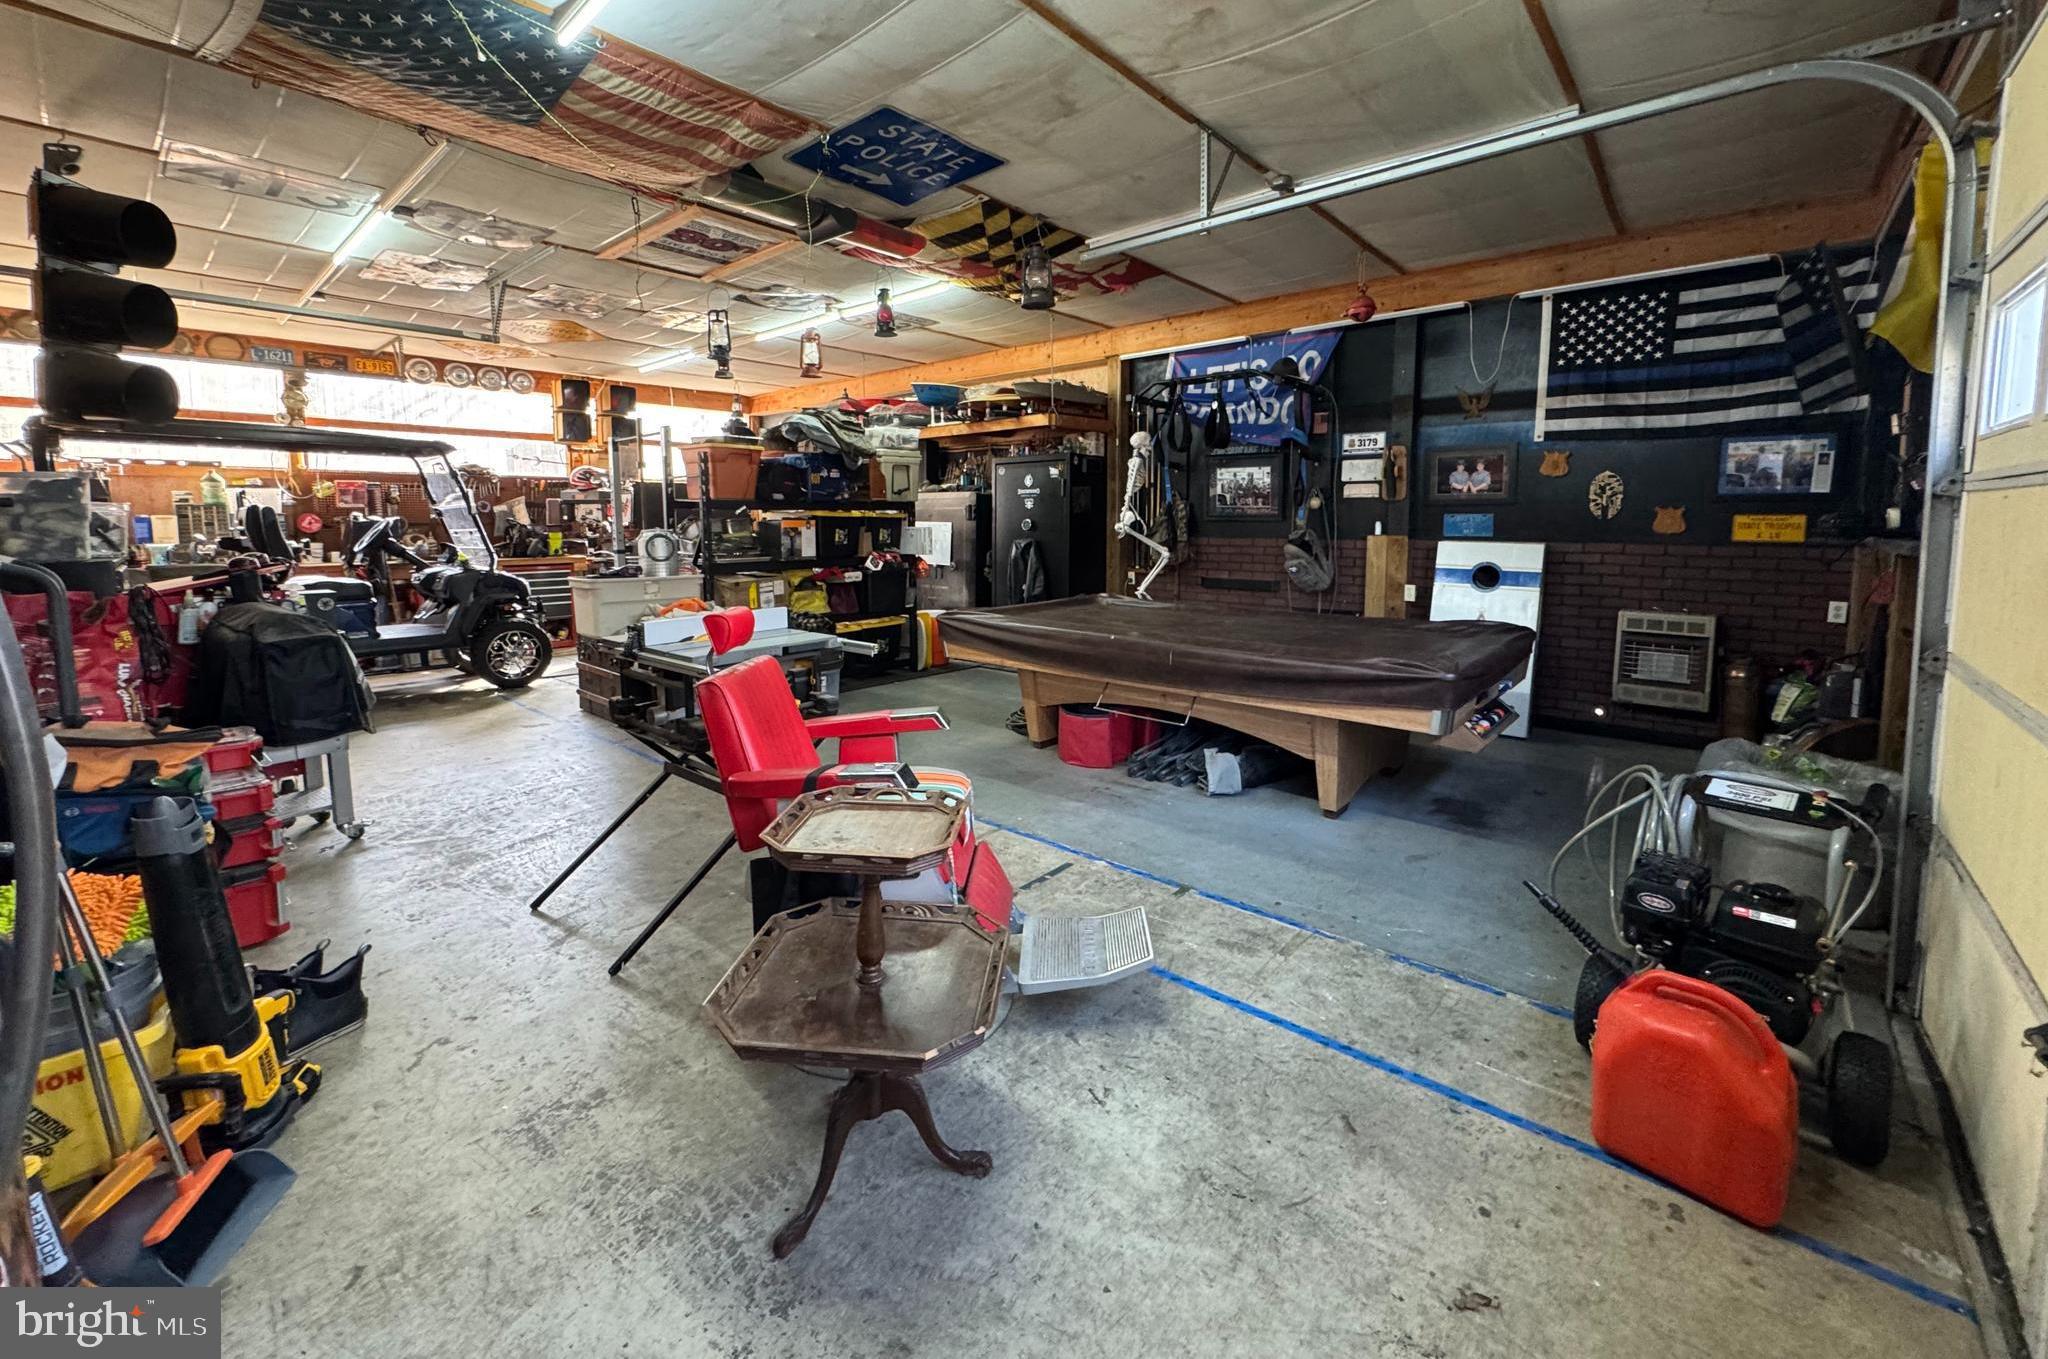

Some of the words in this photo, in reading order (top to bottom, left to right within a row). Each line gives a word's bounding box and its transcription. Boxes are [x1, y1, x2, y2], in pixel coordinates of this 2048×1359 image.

[836, 135, 950, 186] POLICE
[878, 124, 975, 170] STATE
[1186, 359, 1269, 394] LET'S
[1357, 438, 1378, 448] 3179
[35, 1066, 84, 1095] ION
